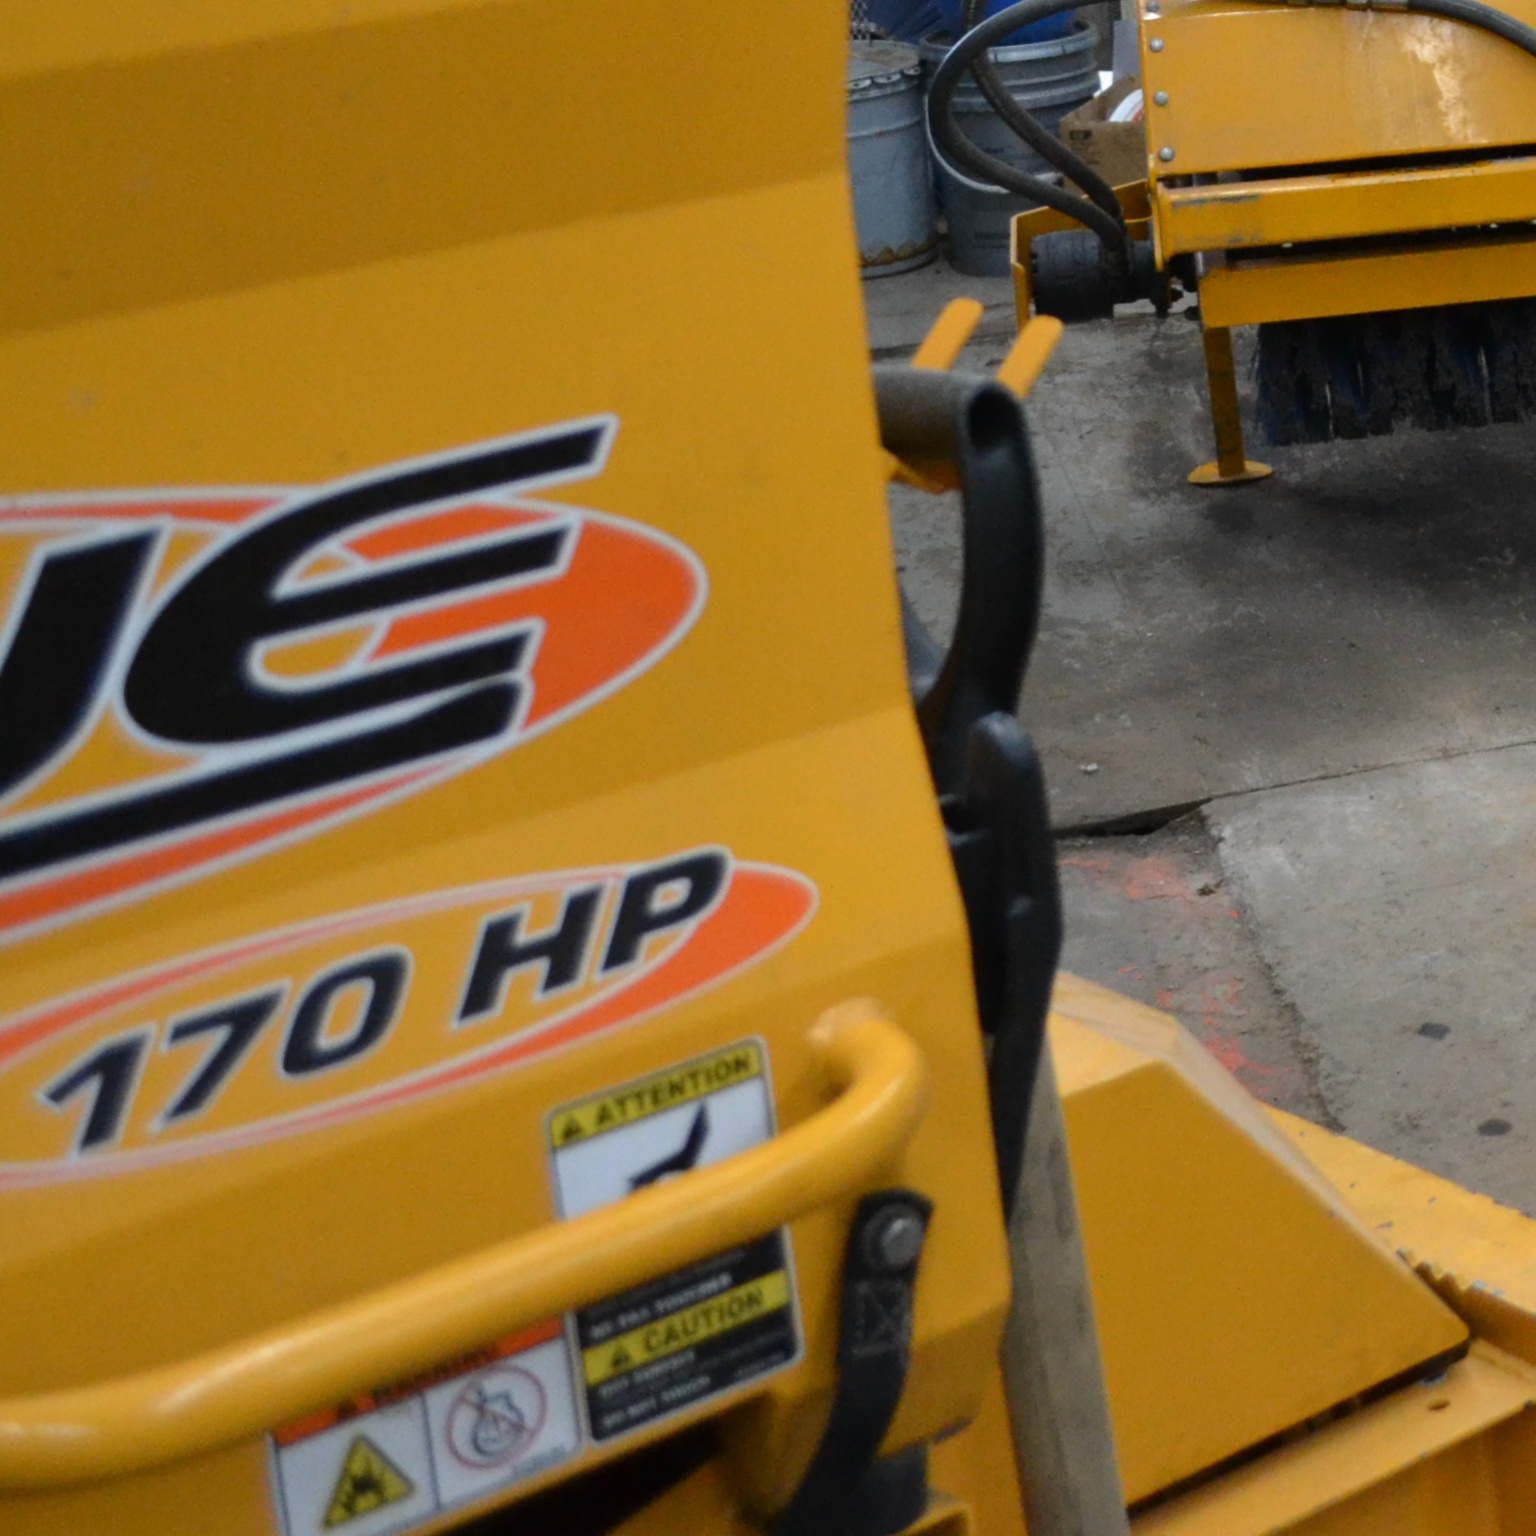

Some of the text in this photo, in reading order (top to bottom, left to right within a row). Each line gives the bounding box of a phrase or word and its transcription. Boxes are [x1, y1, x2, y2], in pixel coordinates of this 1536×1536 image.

[40, 848, 730, 1156] 170 HP
[594, 1052, 751, 1127] ATTENTION
[642, 1285, 765, 1354] CAUTION
